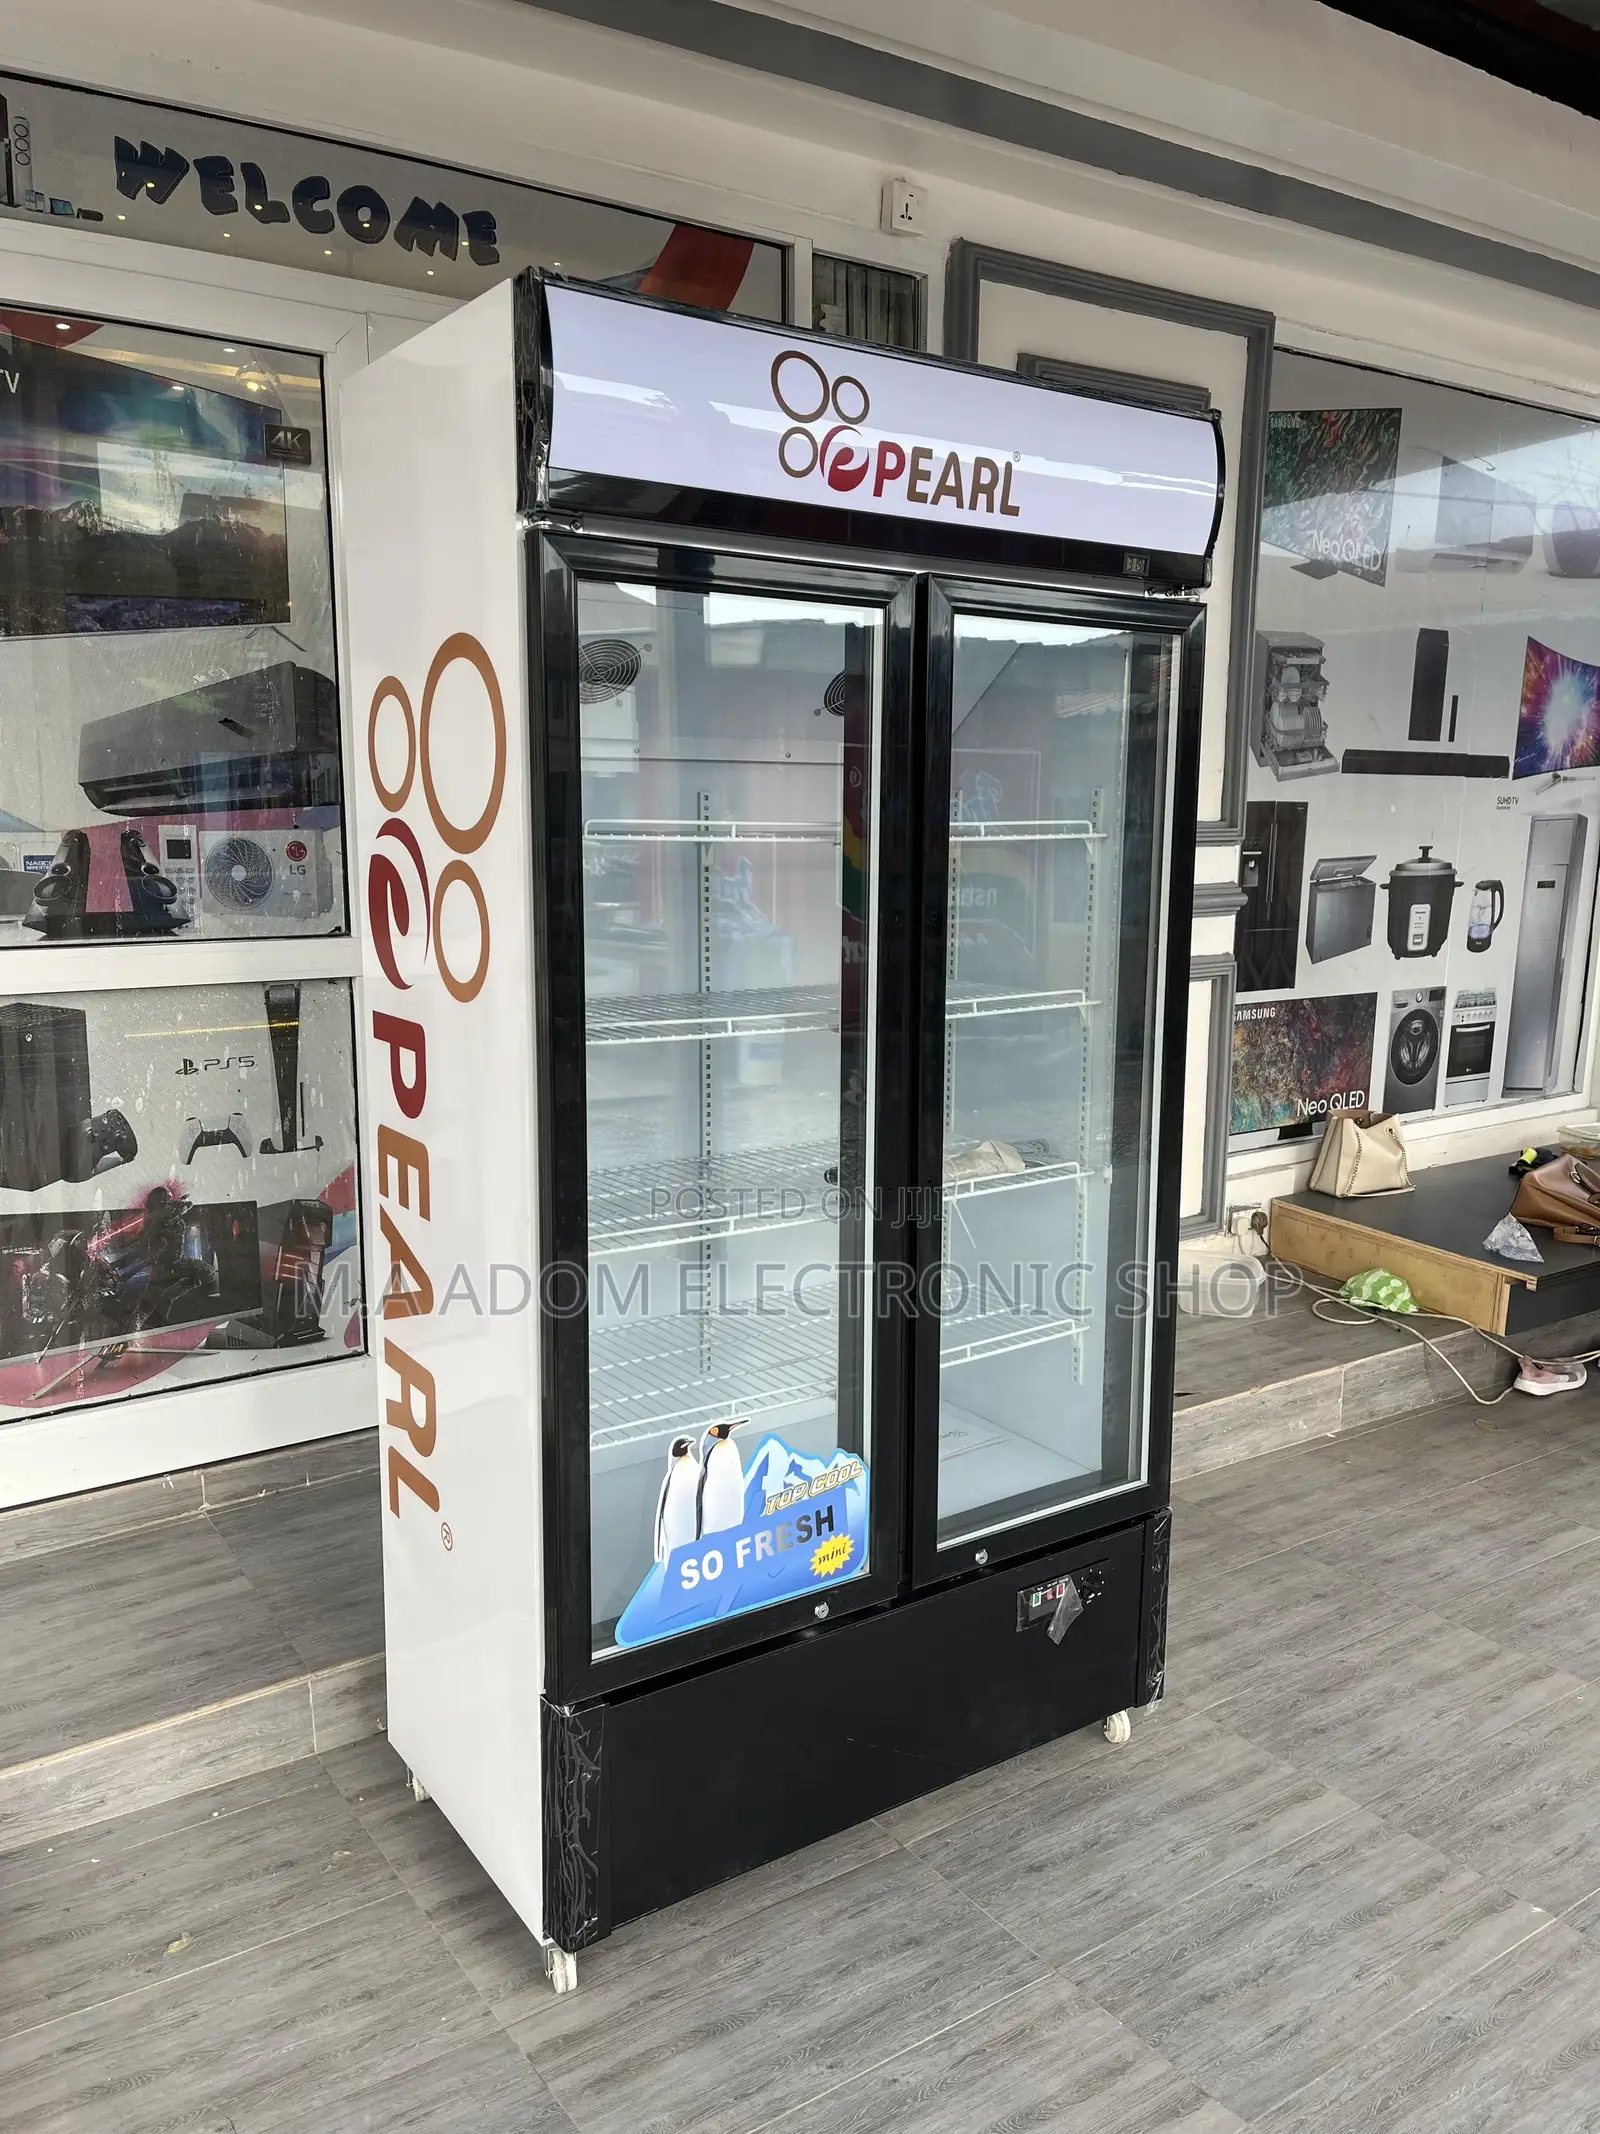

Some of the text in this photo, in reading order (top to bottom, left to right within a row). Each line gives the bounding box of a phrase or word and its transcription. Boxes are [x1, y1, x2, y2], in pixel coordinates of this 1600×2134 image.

[114, 135, 500, 266] WELCOME
[1270, 417, 1300, 429] SAMSUNG
[271, 430, 303, 452] 4K
[872, 440, 1021, 517] PEARL
[1310, 529, 1381, 571] Neo QLED
[1496, 796, 1520, 805] SUHD TV
[289, 864, 306, 876] LG
[204, 1055, 256, 1071] PS5
[1297, 1090, 1366, 1117] Neo QLED
[372, 1010, 441, 1520] PEARL
[765, 1460, 864, 1515] TOP COOL
[680, 1504, 835, 1590] SO FRESH
[817, 1542, 848, 1566] mini
